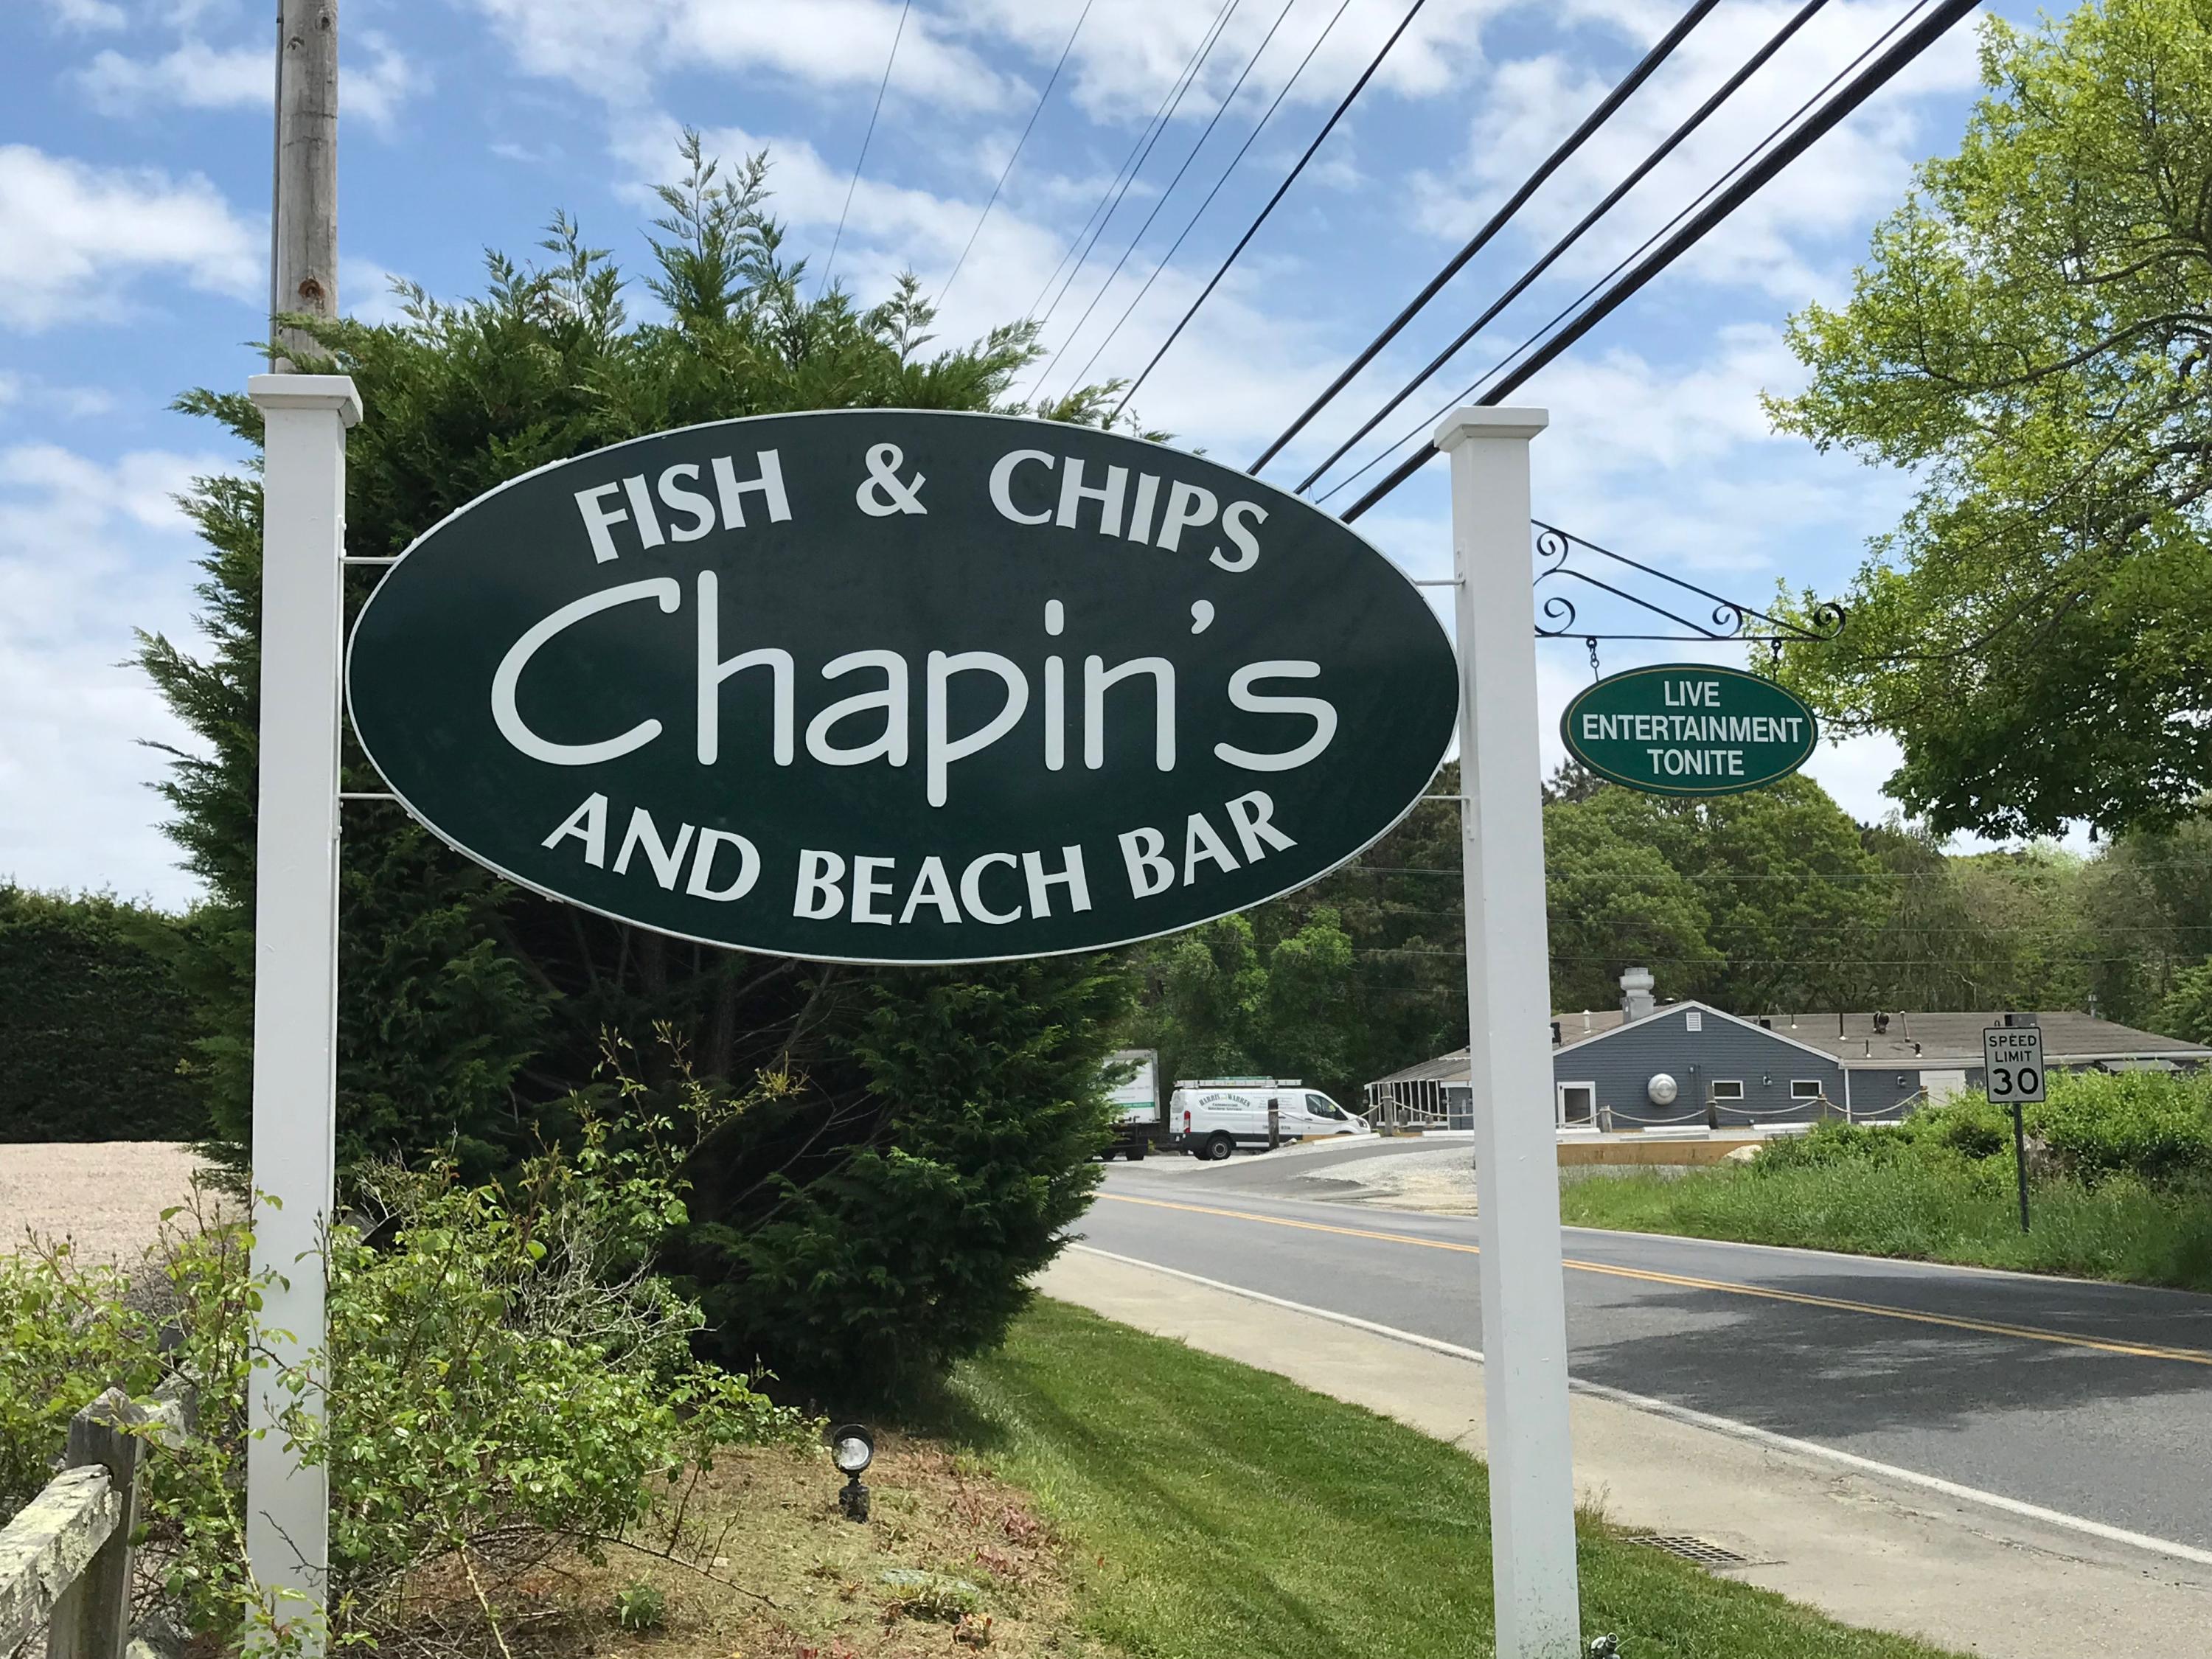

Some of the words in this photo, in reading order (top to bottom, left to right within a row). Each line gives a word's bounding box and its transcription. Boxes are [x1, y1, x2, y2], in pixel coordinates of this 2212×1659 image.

[574, 449, 792, 563] FISH
[856, 443, 927, 516] &
[990, 450, 1268, 572] CHIPS
[492, 570, 1337, 807] Chapin's
[1664, 681, 1721, 707] LIVE
[1582, 714, 1803, 743] ENTERTAINMENT
[1646, 748, 1745, 776] TONITE
[541, 792, 760, 901] AND
[793, 844, 1091, 925] BEACH
[1118, 791, 1298, 899] BAR
[1989, 1034, 2037, 1048] SPEED
[1994, 1050, 2032, 1062] LIMIT
[1992, 1067, 2039, 1096] 30
